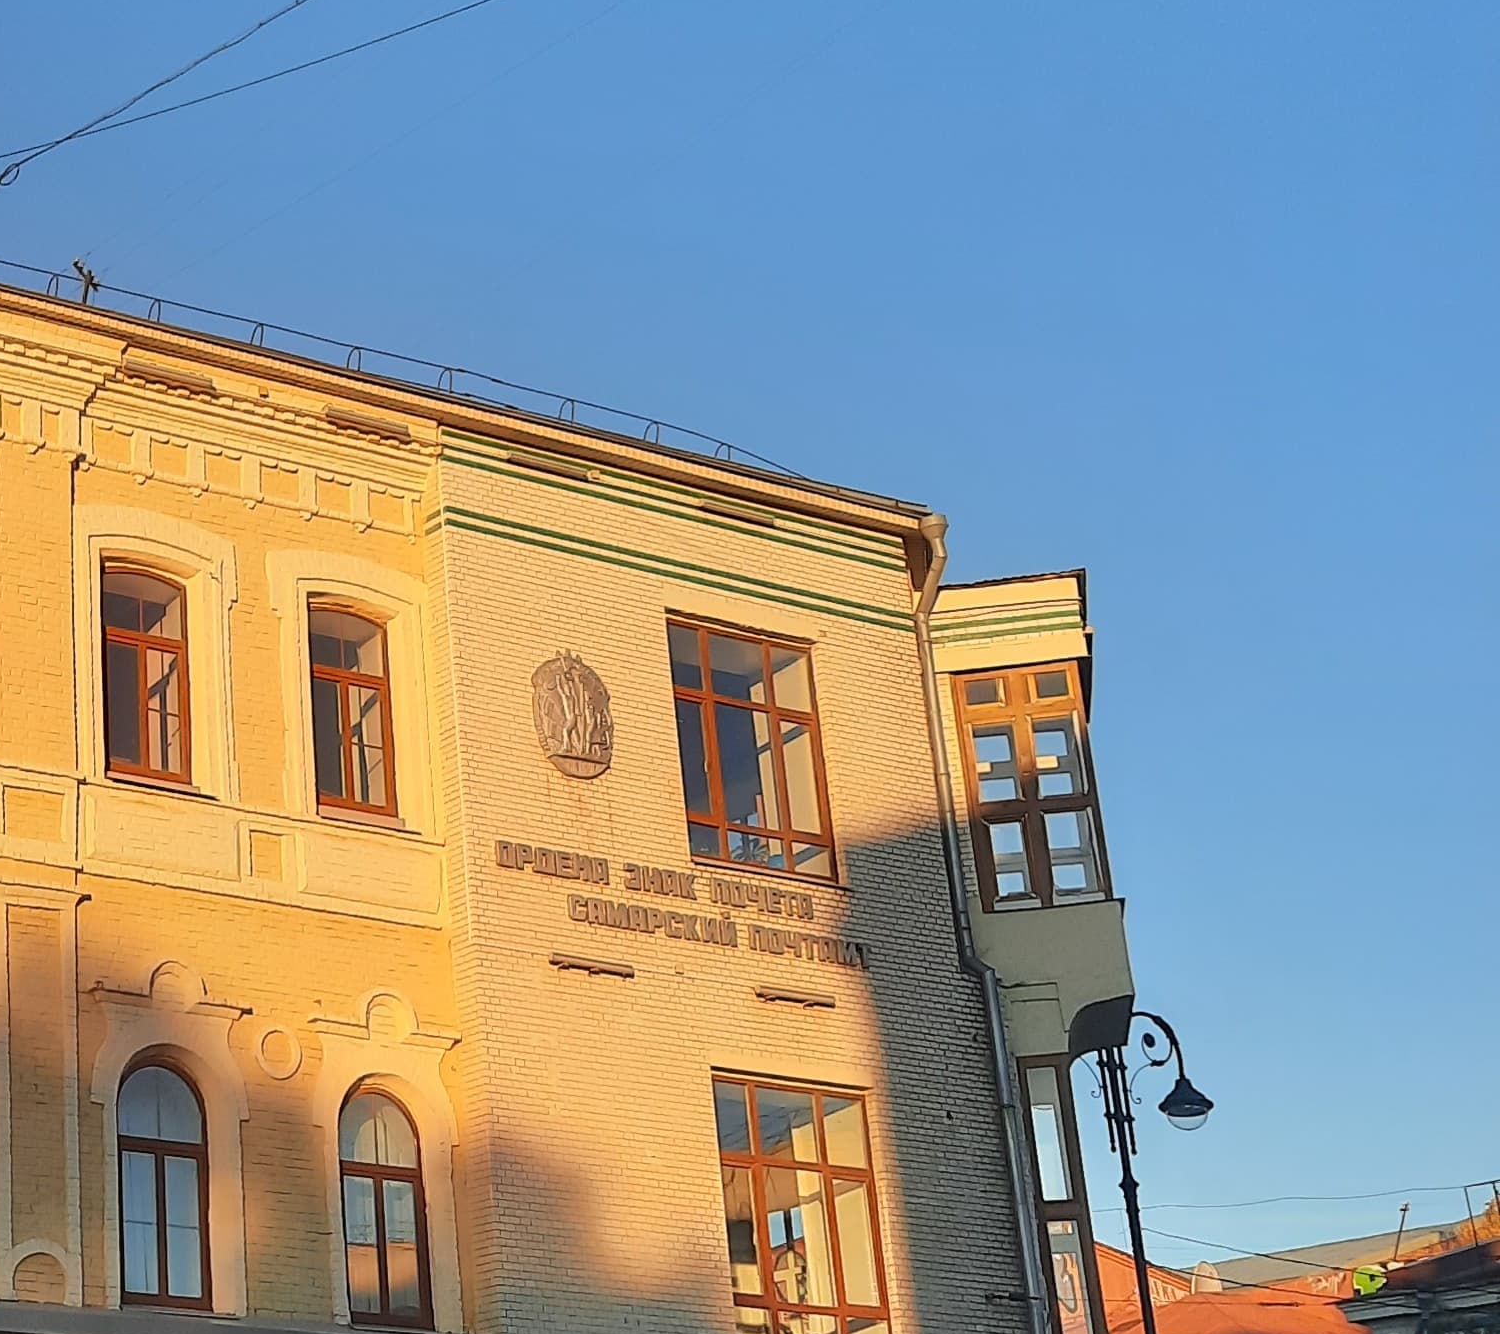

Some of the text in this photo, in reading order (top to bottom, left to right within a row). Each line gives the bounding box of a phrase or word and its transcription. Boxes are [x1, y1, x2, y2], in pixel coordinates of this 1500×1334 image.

[495, 840, 610, 885] ОРДЕНА
[624, 863, 698, 900] ЗНАК
[568, 894, 872, 969] САМАРСКИЙ ПОЧТАМТ
